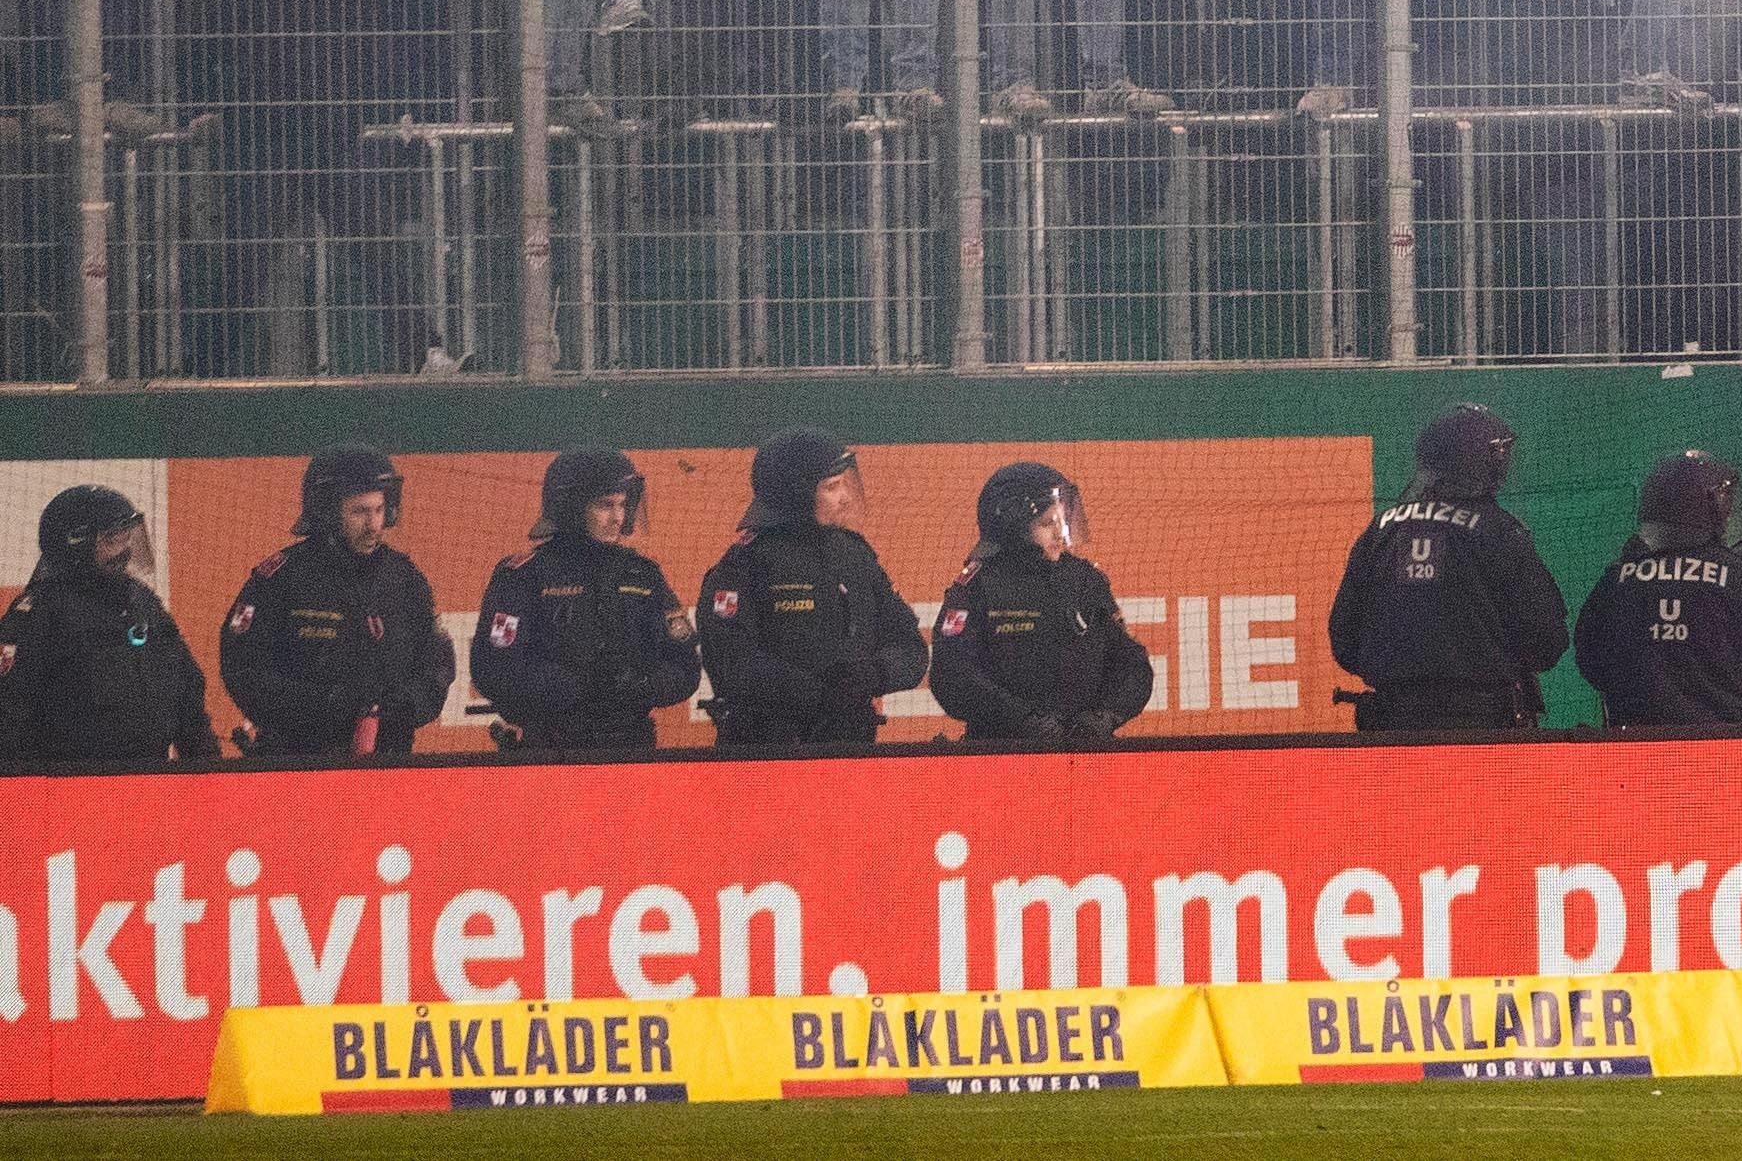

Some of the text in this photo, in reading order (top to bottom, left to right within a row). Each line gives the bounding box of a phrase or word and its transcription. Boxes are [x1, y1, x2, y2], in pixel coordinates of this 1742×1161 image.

[1380, 502, 1480, 530] POLIZEI
[1412, 538, 1431, 561] U
[1406, 564, 1435, 579] 120
[1619, 557, 1728, 587] POLIZEI
[1659, 599, 1681, 621] U
[1650, 624, 1689, 641] 120
[934, 831, 1480, 993] immer
[1307, 979, 1638, 1055] BLÅKLÄDER
[334, 1004, 676, 1080] BLÅKLÄDER
[791, 996, 1125, 1069] BLÅKLÄDER
[1461, 1060, 1614, 1079] WORKWEAR
